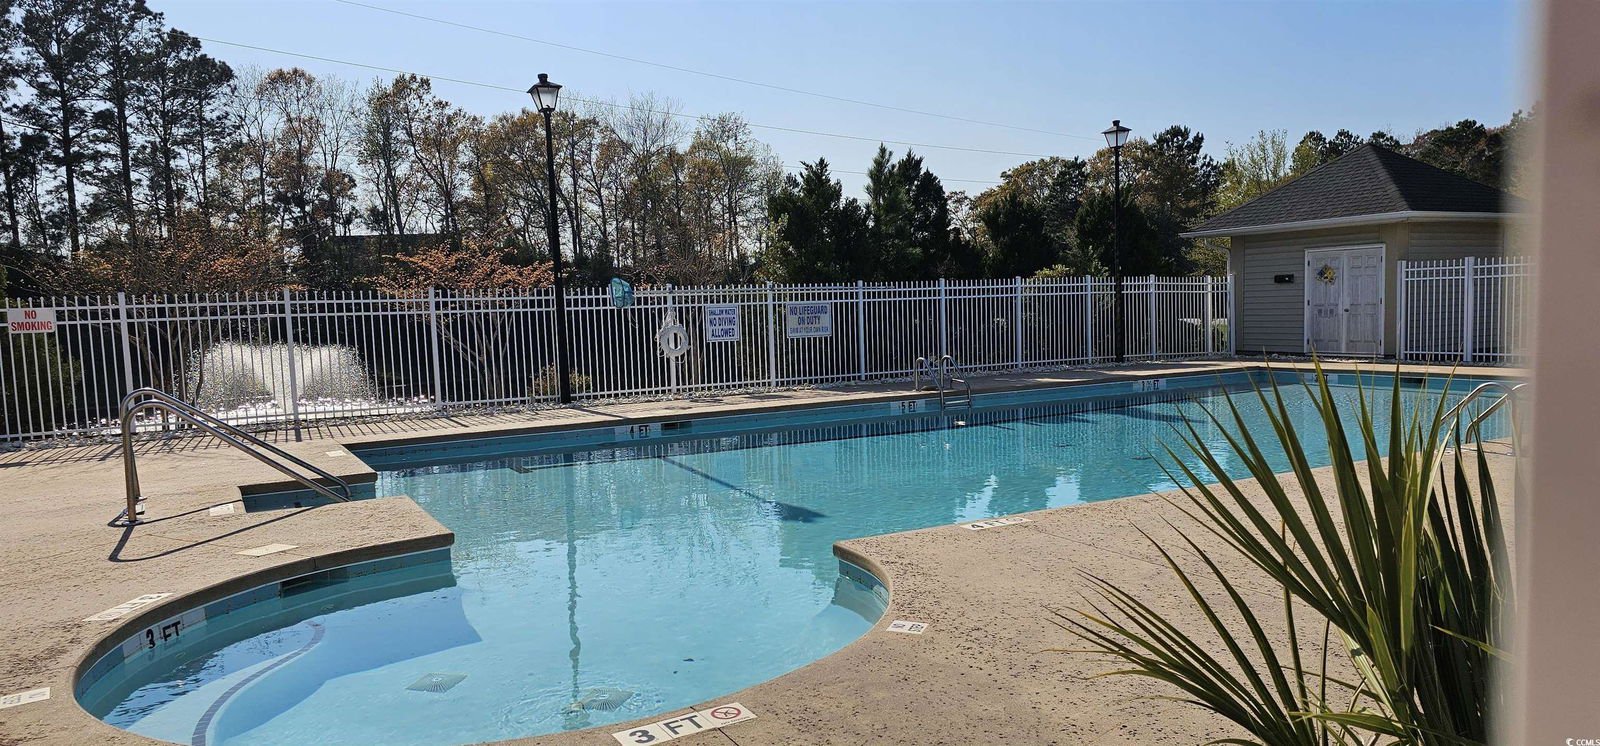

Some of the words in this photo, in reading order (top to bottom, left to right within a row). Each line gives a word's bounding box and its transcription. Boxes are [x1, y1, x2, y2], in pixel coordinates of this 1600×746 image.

[24, 310, 37, 319] NO
[789, 305, 798, 315] NO
[799, 305, 828, 315] LIFEGUARD
[709, 317, 717, 327] NO
[717, 316, 736, 327] DIVING
[797, 316, 805, 326] ON
[807, 315, 821, 325] DUTY
[11, 321, 53, 332] SMOKING
[711, 328, 736, 338] ALLOWED
[145, 628, 156, 649] 3
[162, 620, 181, 642] FT
[629, 729, 656, 744] 3
[663, 714, 703, 735] FT
